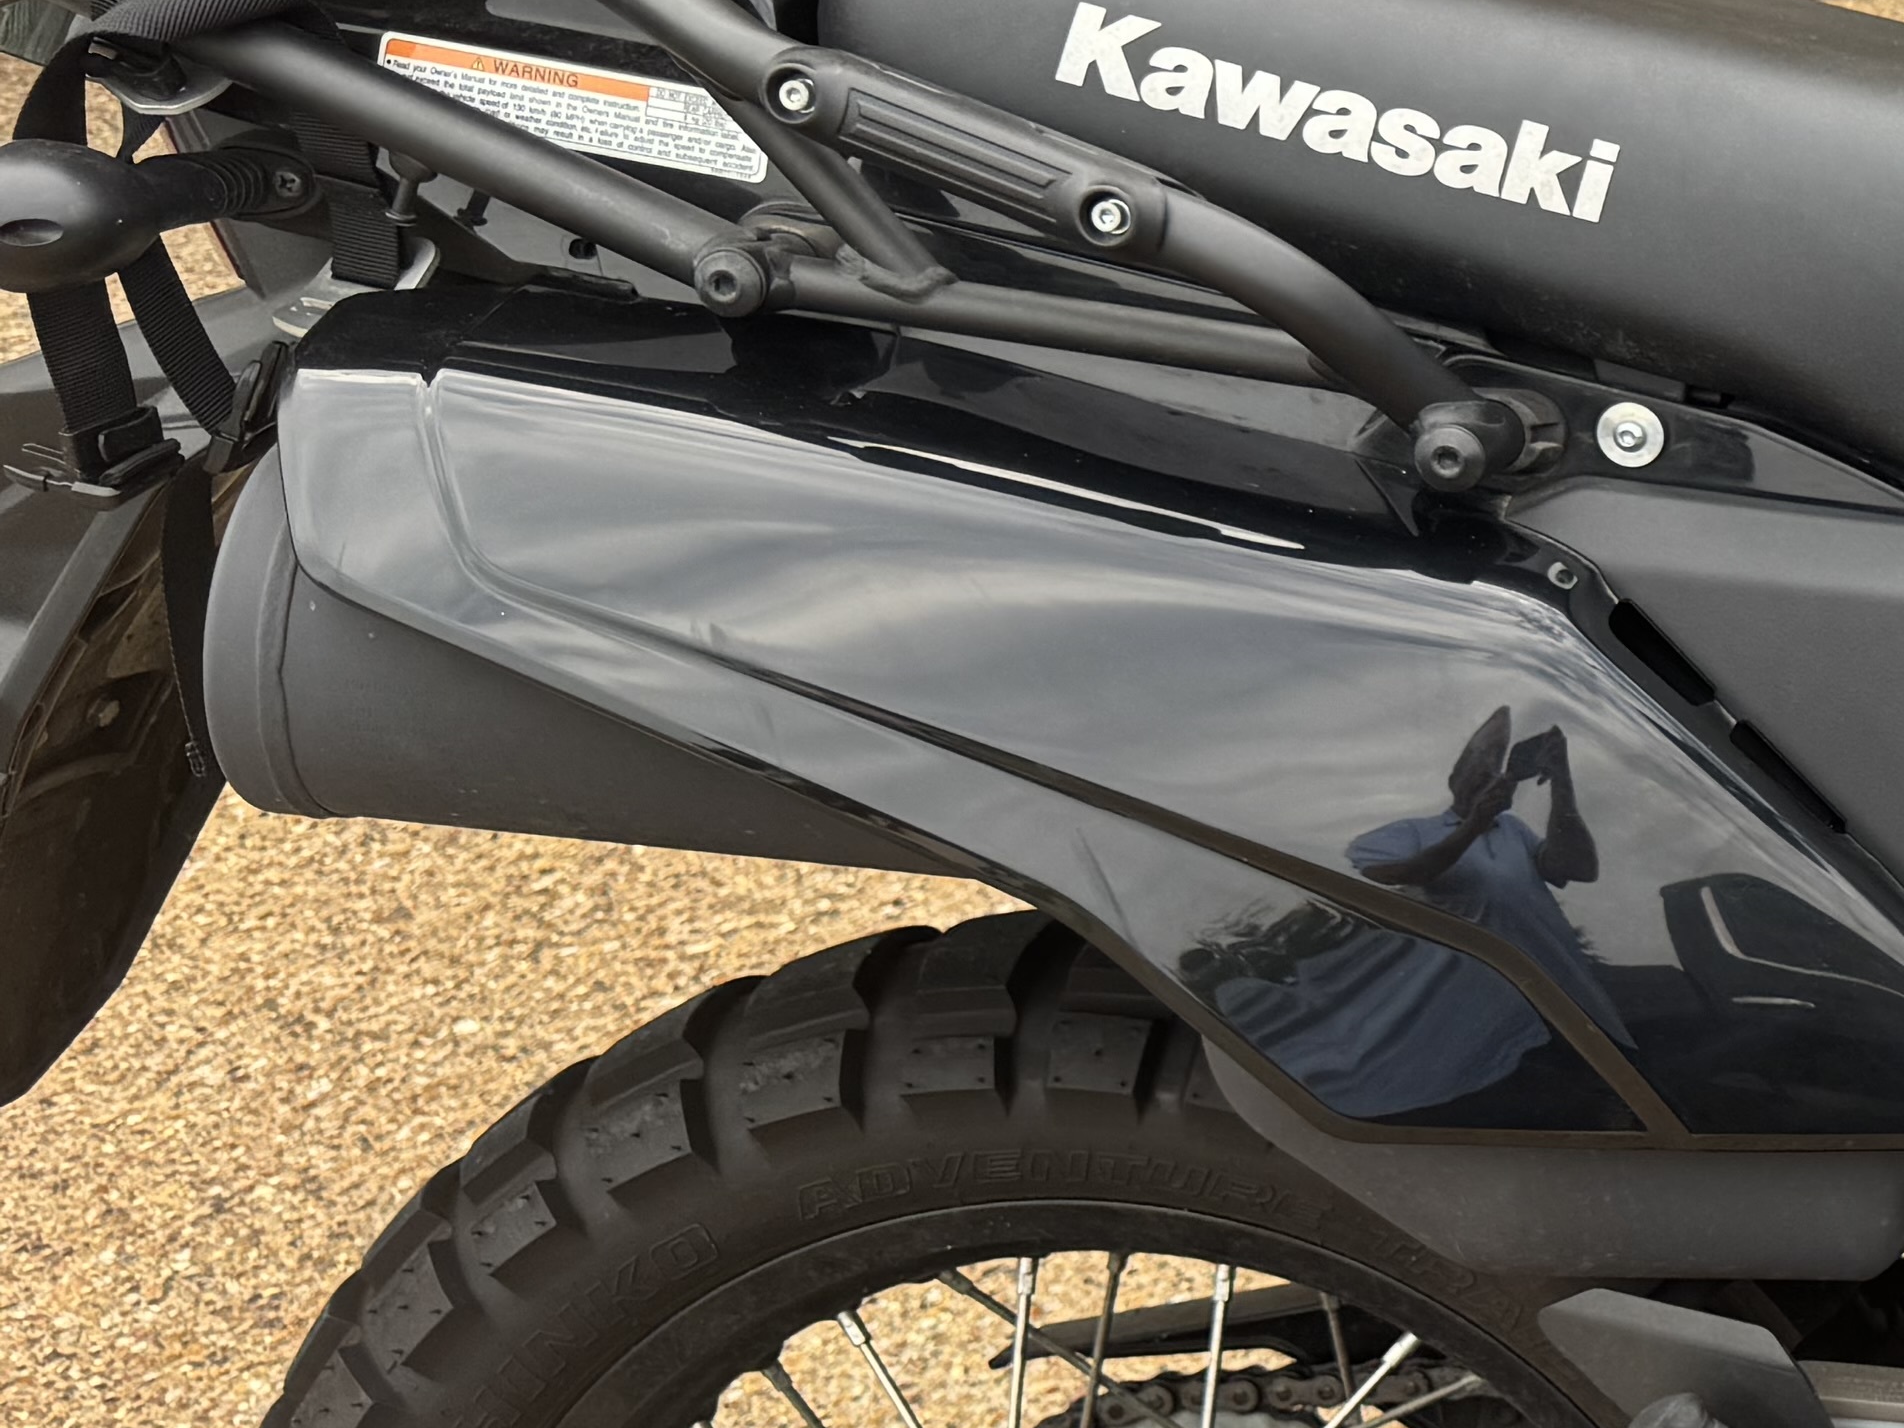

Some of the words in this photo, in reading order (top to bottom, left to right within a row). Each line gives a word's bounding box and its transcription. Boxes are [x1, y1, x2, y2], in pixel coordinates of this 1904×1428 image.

[494, 60, 579, 87] WARNING
[1055, 1, 1621, 223] Kawasaki
[789, 1147, 1333, 1233] ADVENTURE
